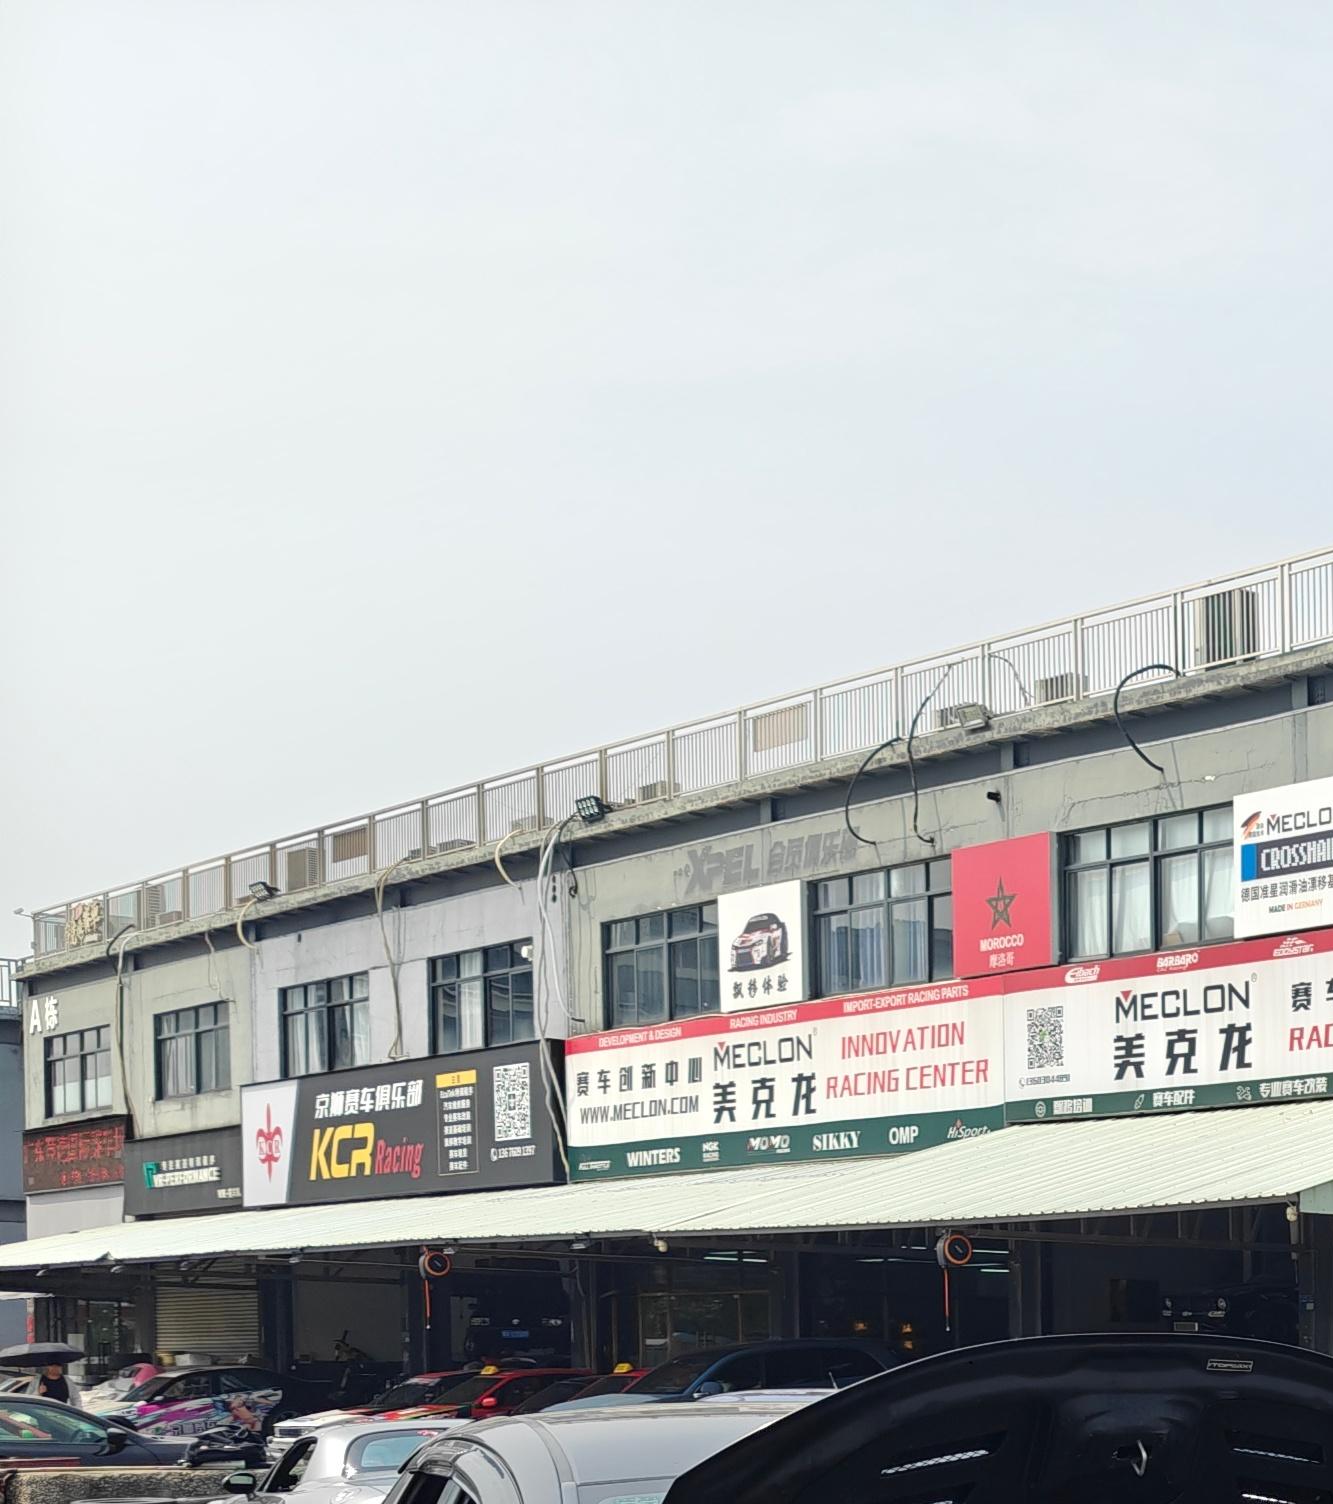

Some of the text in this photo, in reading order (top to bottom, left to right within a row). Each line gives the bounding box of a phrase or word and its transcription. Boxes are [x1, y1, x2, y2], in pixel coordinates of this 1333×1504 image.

[1268, 904, 1285, 913] MADE
[1286, 903, 1294, 911] IN
[979, 933, 1025, 952] MOROCCO
[843, 984, 969, 1013] IMPORT-EXPORT RACING PARTS
[1114, 980, 1250, 1024] MECLON
[729, 1008, 798, 1029] RACING INDUSTRY
[598, 1027, 682, 1048] DEVELOPMENT & DESIGN
[840, 1020, 966, 1060] INNOVATION
[713, 1033, 813, 1072] MECLON
[1113, 1022, 1253, 1081] 美克龙
[576, 1056, 703, 1097] 赛车创新中心
[826, 1058, 989, 1100] RACING CENTER
[1259, 1076, 1328, 1098] 专业赛车改装
[579, 1094, 700, 1125] WWW.MECLON.COM
[712, 1072, 817, 1124] 美克龙
[1152, 1089, 1196, 1108] 赛车配件
[749, 1134, 791, 1151] MOMO
[812, 1131, 861, 1150] SIKKY
[888, 1125, 920, 1145] OMP
[308, 1121, 425, 1181] KCR Racing
[626, 1147, 681, 1168] WINTERS
